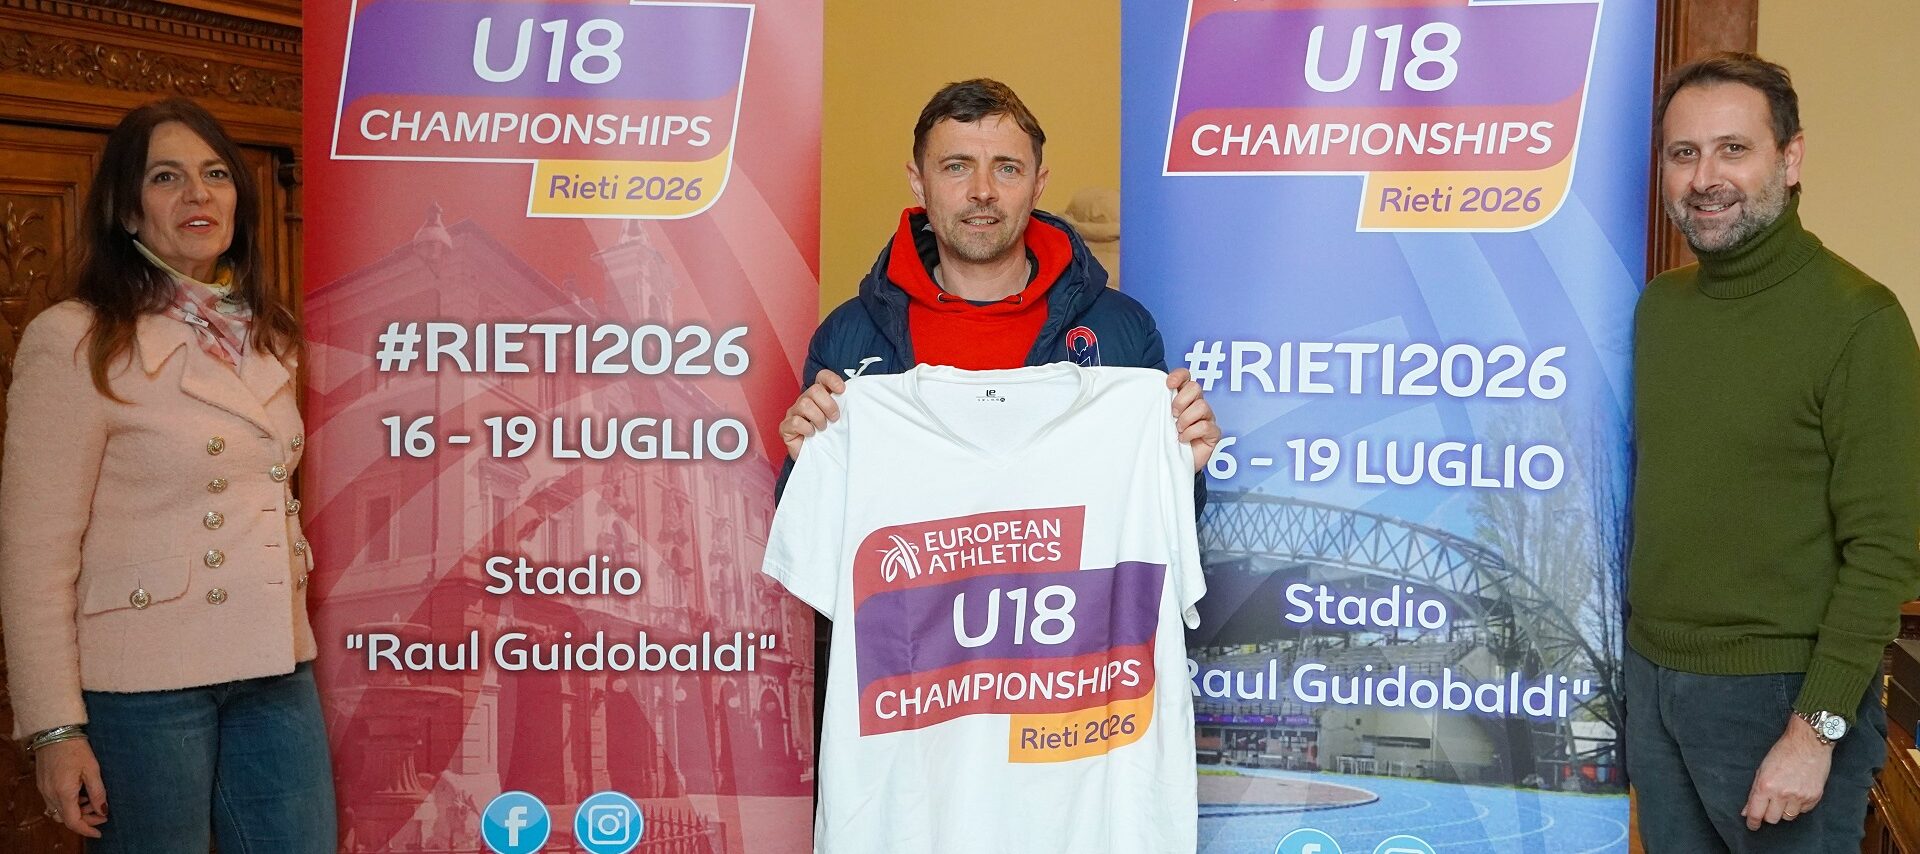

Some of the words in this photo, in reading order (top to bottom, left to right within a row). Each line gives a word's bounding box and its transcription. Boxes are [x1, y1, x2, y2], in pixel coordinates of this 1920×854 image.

[473, 17, 625, 84] U18
[1303, 22, 1462, 93] U18
[360, 109, 713, 146] CHAMPIONSHIPS
[1190, 121, 1554, 156] CHAMPIONSHIPS
[549, 175, 618, 201] Rieti
[626, 175, 702, 202] 2026
[1379, 186, 1453, 213] Rieti
[1459, 186, 1543, 214] 2026
[376, 322, 750, 376] #RIETI2026
[1184, 340, 1567, 400] #RIETI2026
[381, 415, 436, 458] 16
[483, 416, 537, 458] 19
[552, 417, 749, 461] LUGLIO
[1207, 436, 1237, 480] 6
[1286, 438, 1341, 482] 19
[1356, 440, 1565, 491] LUGLIO
[924, 518, 1061, 552] EUROPEAN
[928, 541, 1062, 575] ATHLETICS
[485, 555, 642, 596] Stadio
[953, 585, 1077, 648] U18
[1284, 583, 1447, 630] Stadio
[346, 631, 479, 671] "Raul
[494, 631, 776, 672] Guidobaldi"
[875, 658, 1142, 720] CHAMPIONSHIPS
[1292, 658, 1591, 718] Guidobaldi"
[1020, 723, 1078, 750] Rieti
[1084, 713, 1136, 744] 2026
